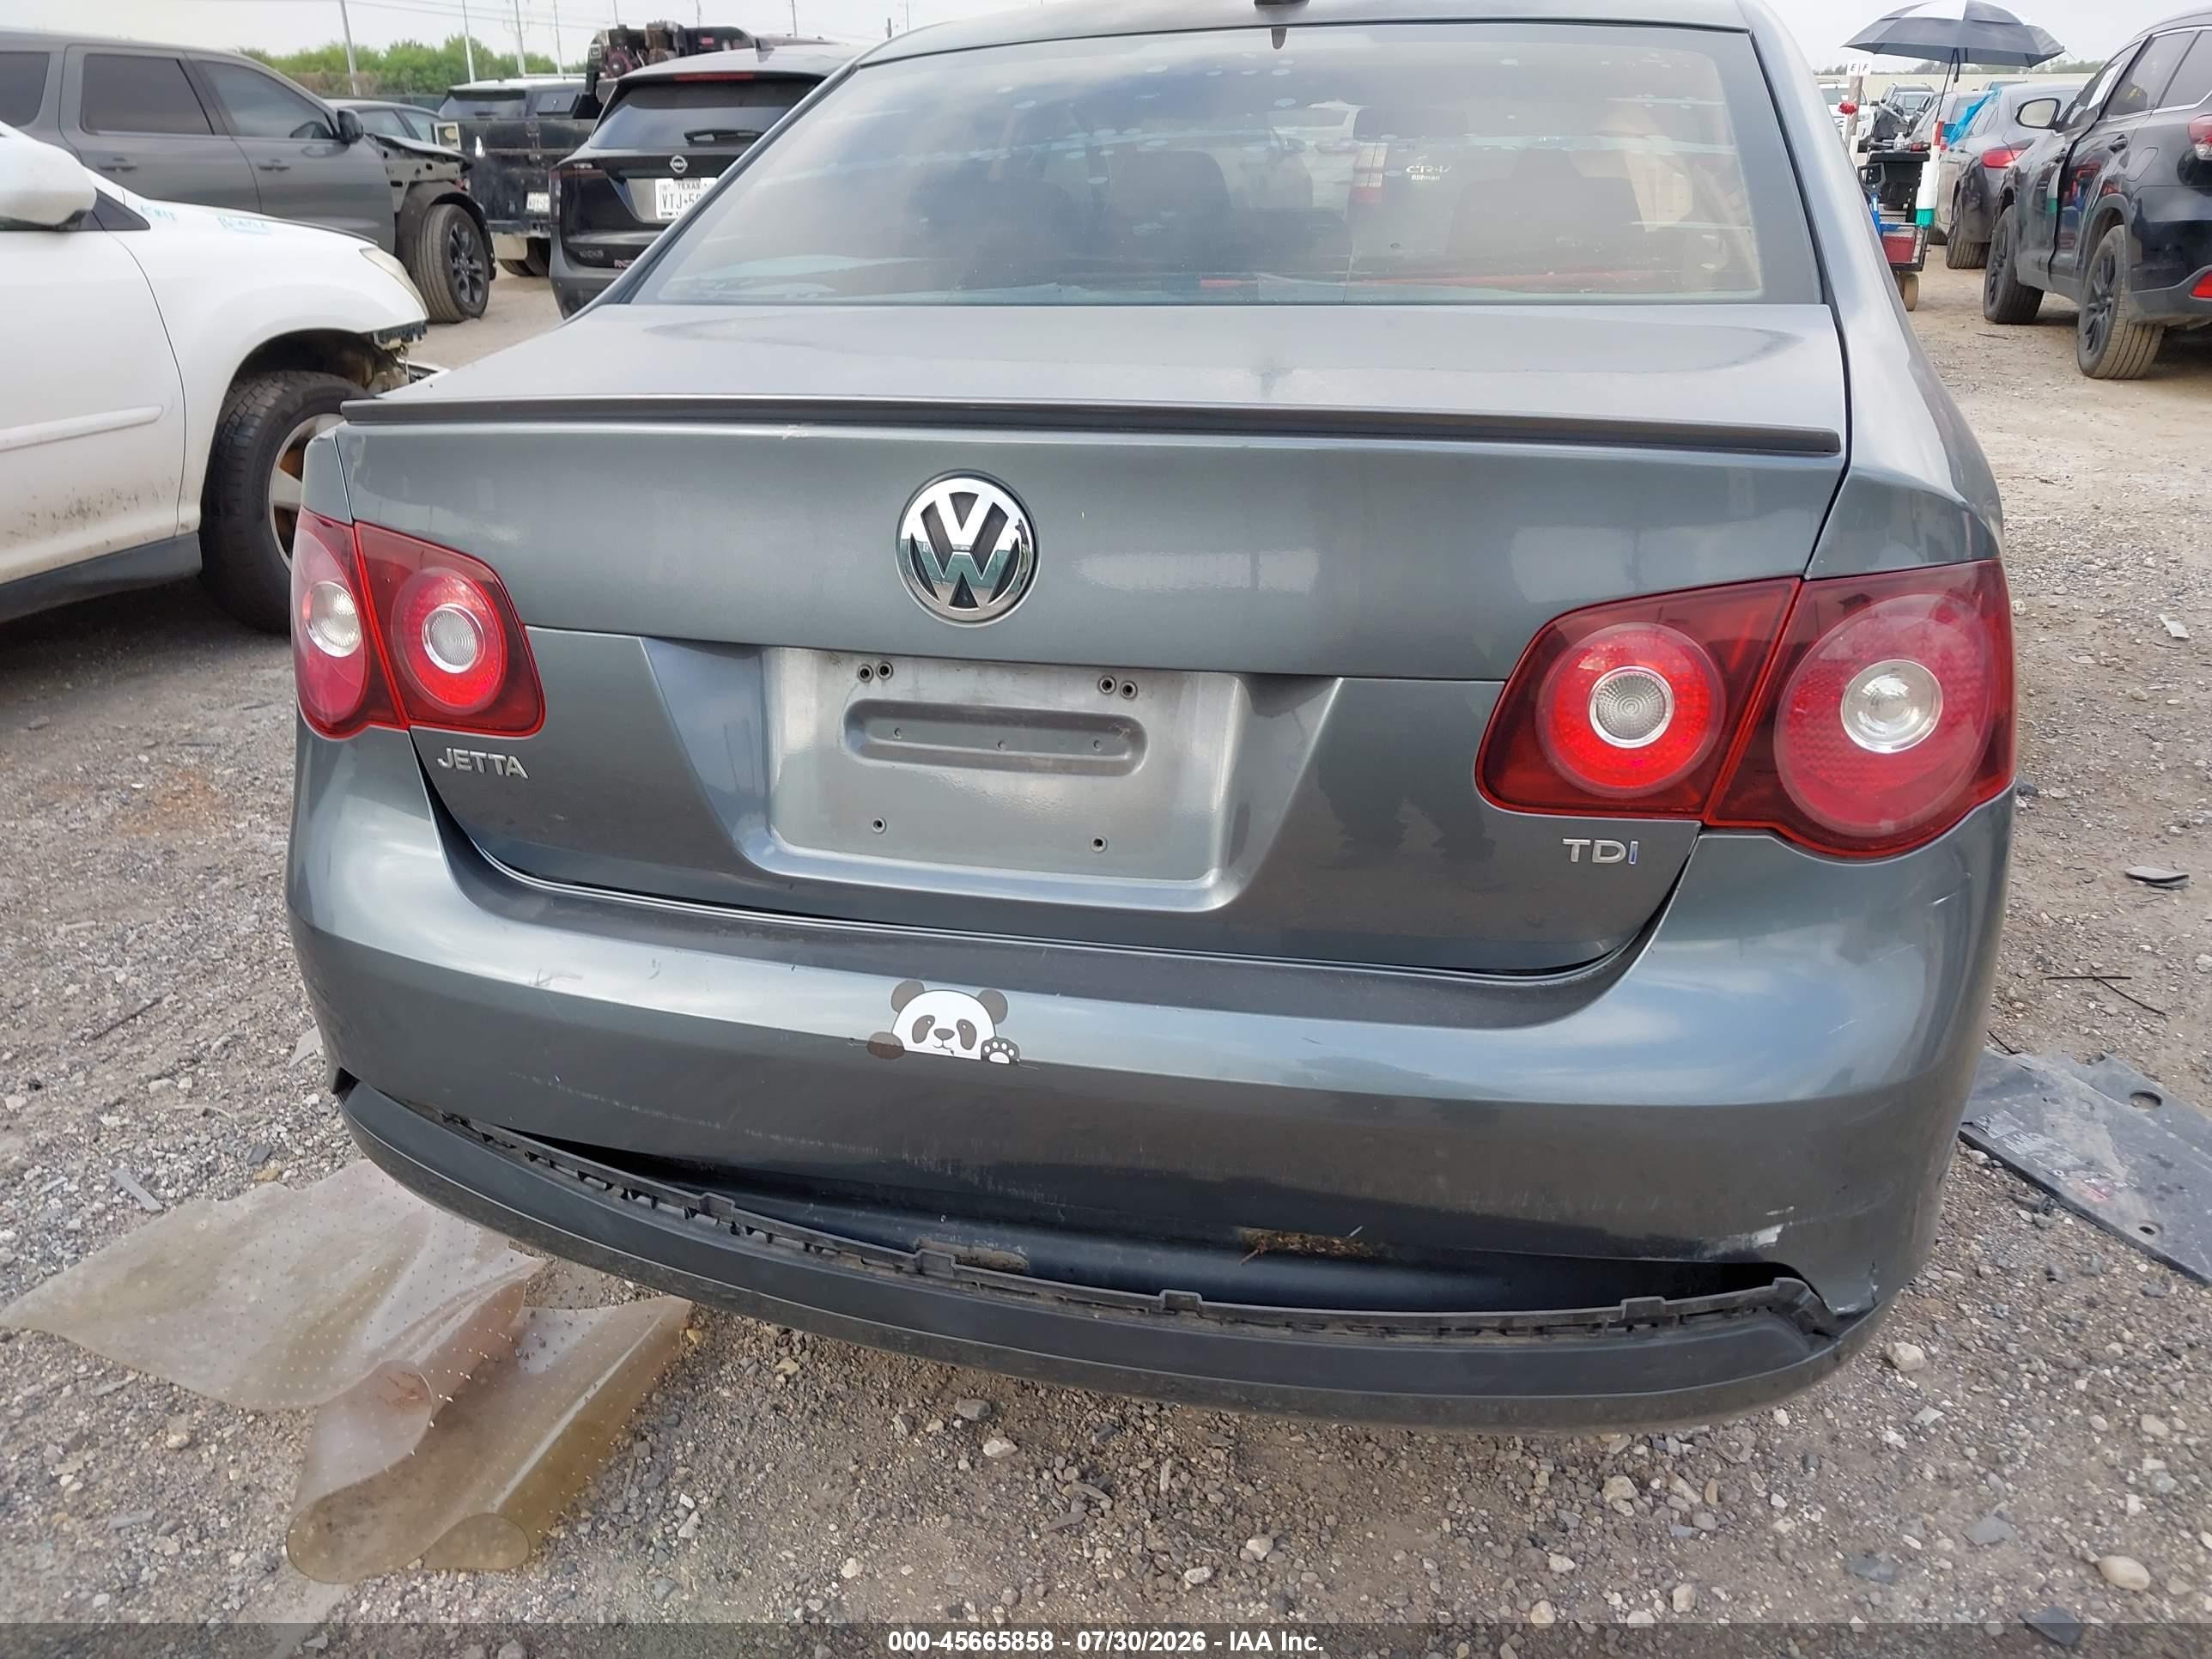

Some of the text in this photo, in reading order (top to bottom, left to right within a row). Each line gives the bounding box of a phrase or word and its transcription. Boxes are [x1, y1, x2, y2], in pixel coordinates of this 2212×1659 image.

[1850, 63, 1857, 71] E
[1863, 63, 1869, 71] F
[678, 181, 701, 190] TEXAS
[437, 747, 529, 779] JETTA
[1562, 838, 1639, 865] TDI
